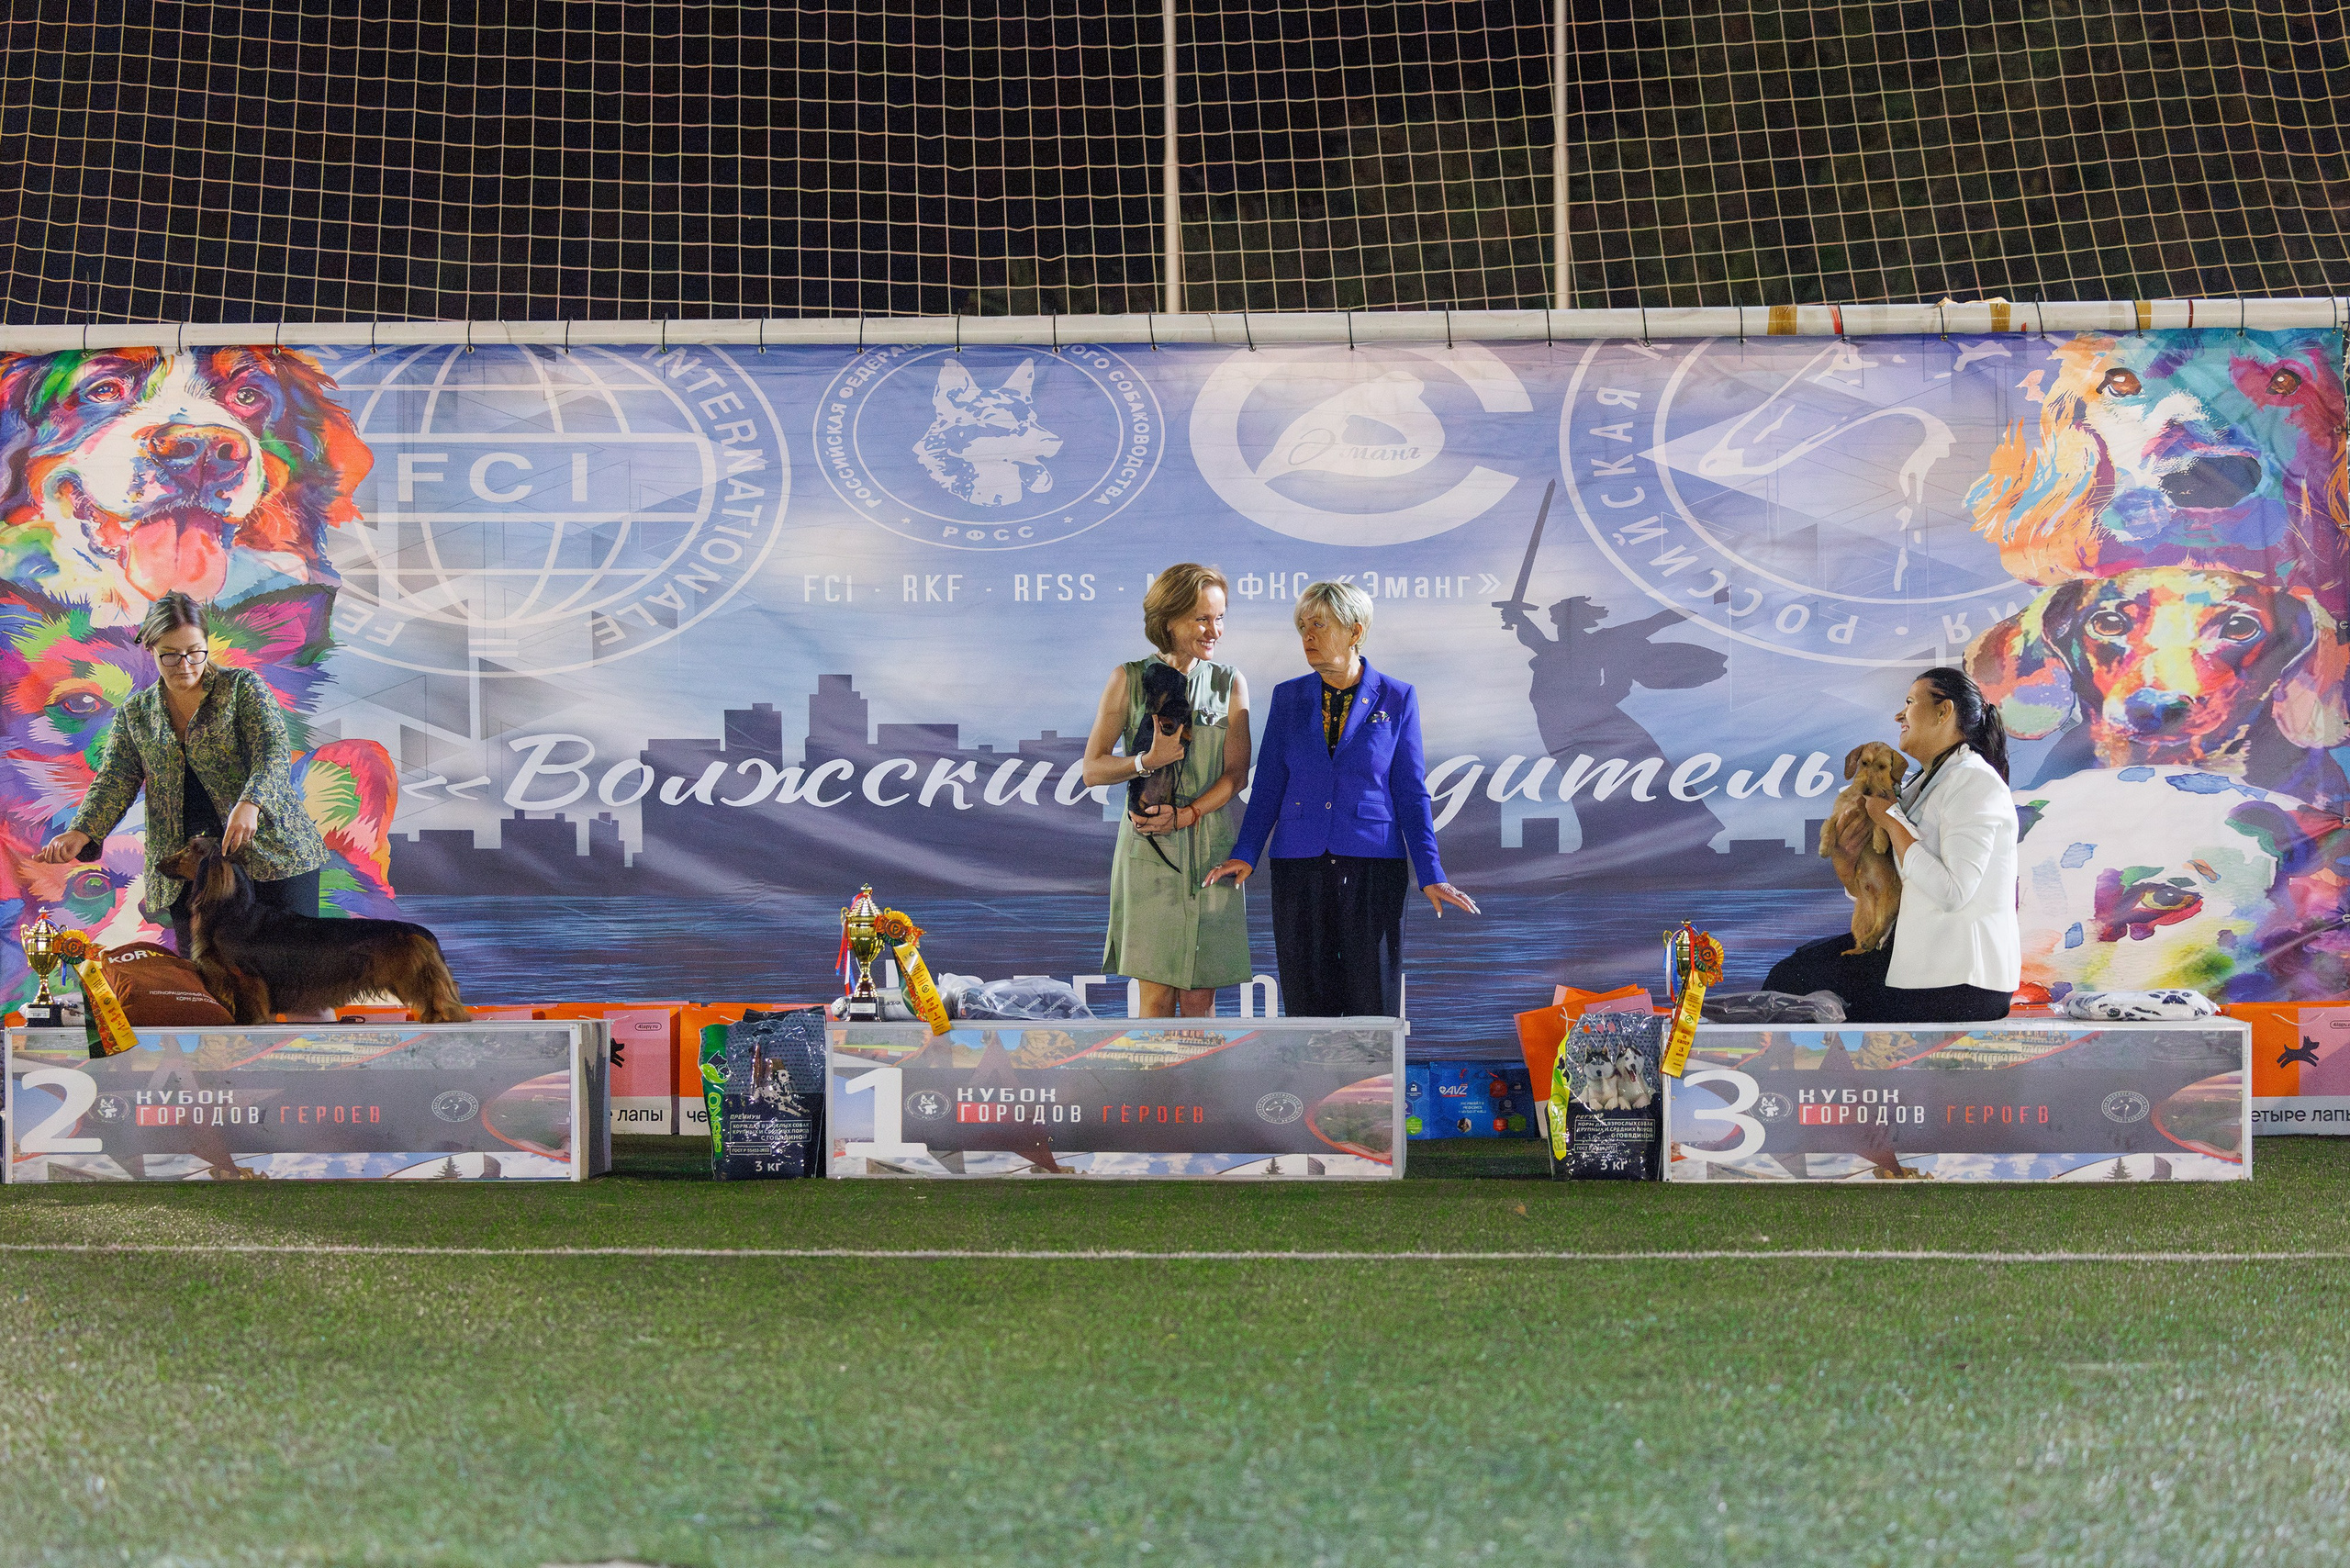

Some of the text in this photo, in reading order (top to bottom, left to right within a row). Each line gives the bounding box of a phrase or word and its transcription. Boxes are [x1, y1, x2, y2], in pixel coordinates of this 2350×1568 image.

[826, 402, 882, 509] РОССИЙСКАЯ
[397, 452, 588, 503] FCI
[942, 524, 1035, 542] РФСС
[803, 574, 853, 603] FCI
[902, 574, 964, 603] RKF
[1013, 573, 1097, 602] RFSS
[136, 1090, 234, 1104] КУБОК
[957, 1087, 1057, 1103] КУБОК
[1798, 1089, 1899, 1103] КУБОК
[20, 1068, 104, 1154] 2
[140, 1106, 260, 1126] ГОРОДОВ
[280, 1105, 381, 1125] ГЕРОЕВ
[617, 1109, 663, 1122] лапы
[845, 1067, 928, 1159] 1
[959, 1103, 1082, 1126] ГОРОДОВ
[1102, 1105, 1203, 1124] ГЕРОЕВ
[1683, 1070, 1767, 1162] 3
[1802, 1105, 1926, 1126] ГОРОДОВ
[2252, 1109, 2307, 1123] етыре
[755, 1160, 763, 1172] 3
[1600, 1159, 1608, 1170] 3
